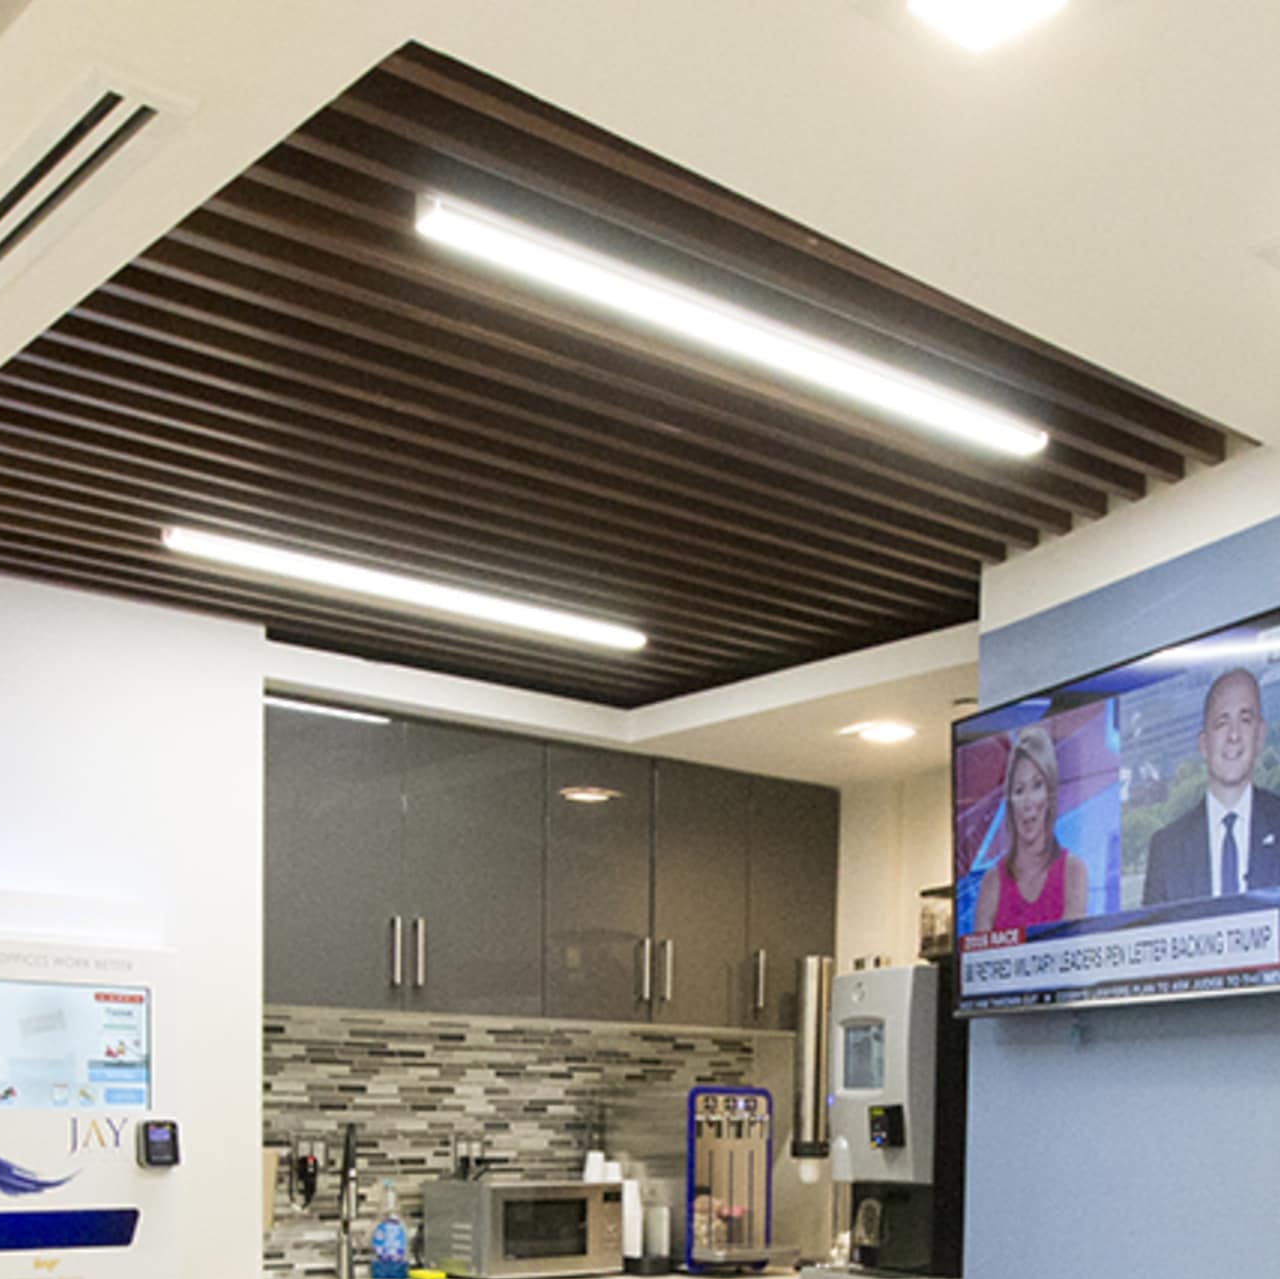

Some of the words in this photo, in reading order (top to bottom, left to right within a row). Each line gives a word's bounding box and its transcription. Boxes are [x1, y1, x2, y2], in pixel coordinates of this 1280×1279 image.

[976, 957, 1012, 982] RETIRED
[1014, 952, 1056, 978] MILITARY
[1058, 947, 1103, 974] LEADERS
[1105, 943, 1126, 968] PEN
[1128, 938, 1168, 965] LETTER
[1170, 930, 1226, 961] BACKING
[1227, 923, 1273, 953] TRUMP
[990, 928, 1020, 944] RACE
[68, 1117, 128, 1155] JAY
